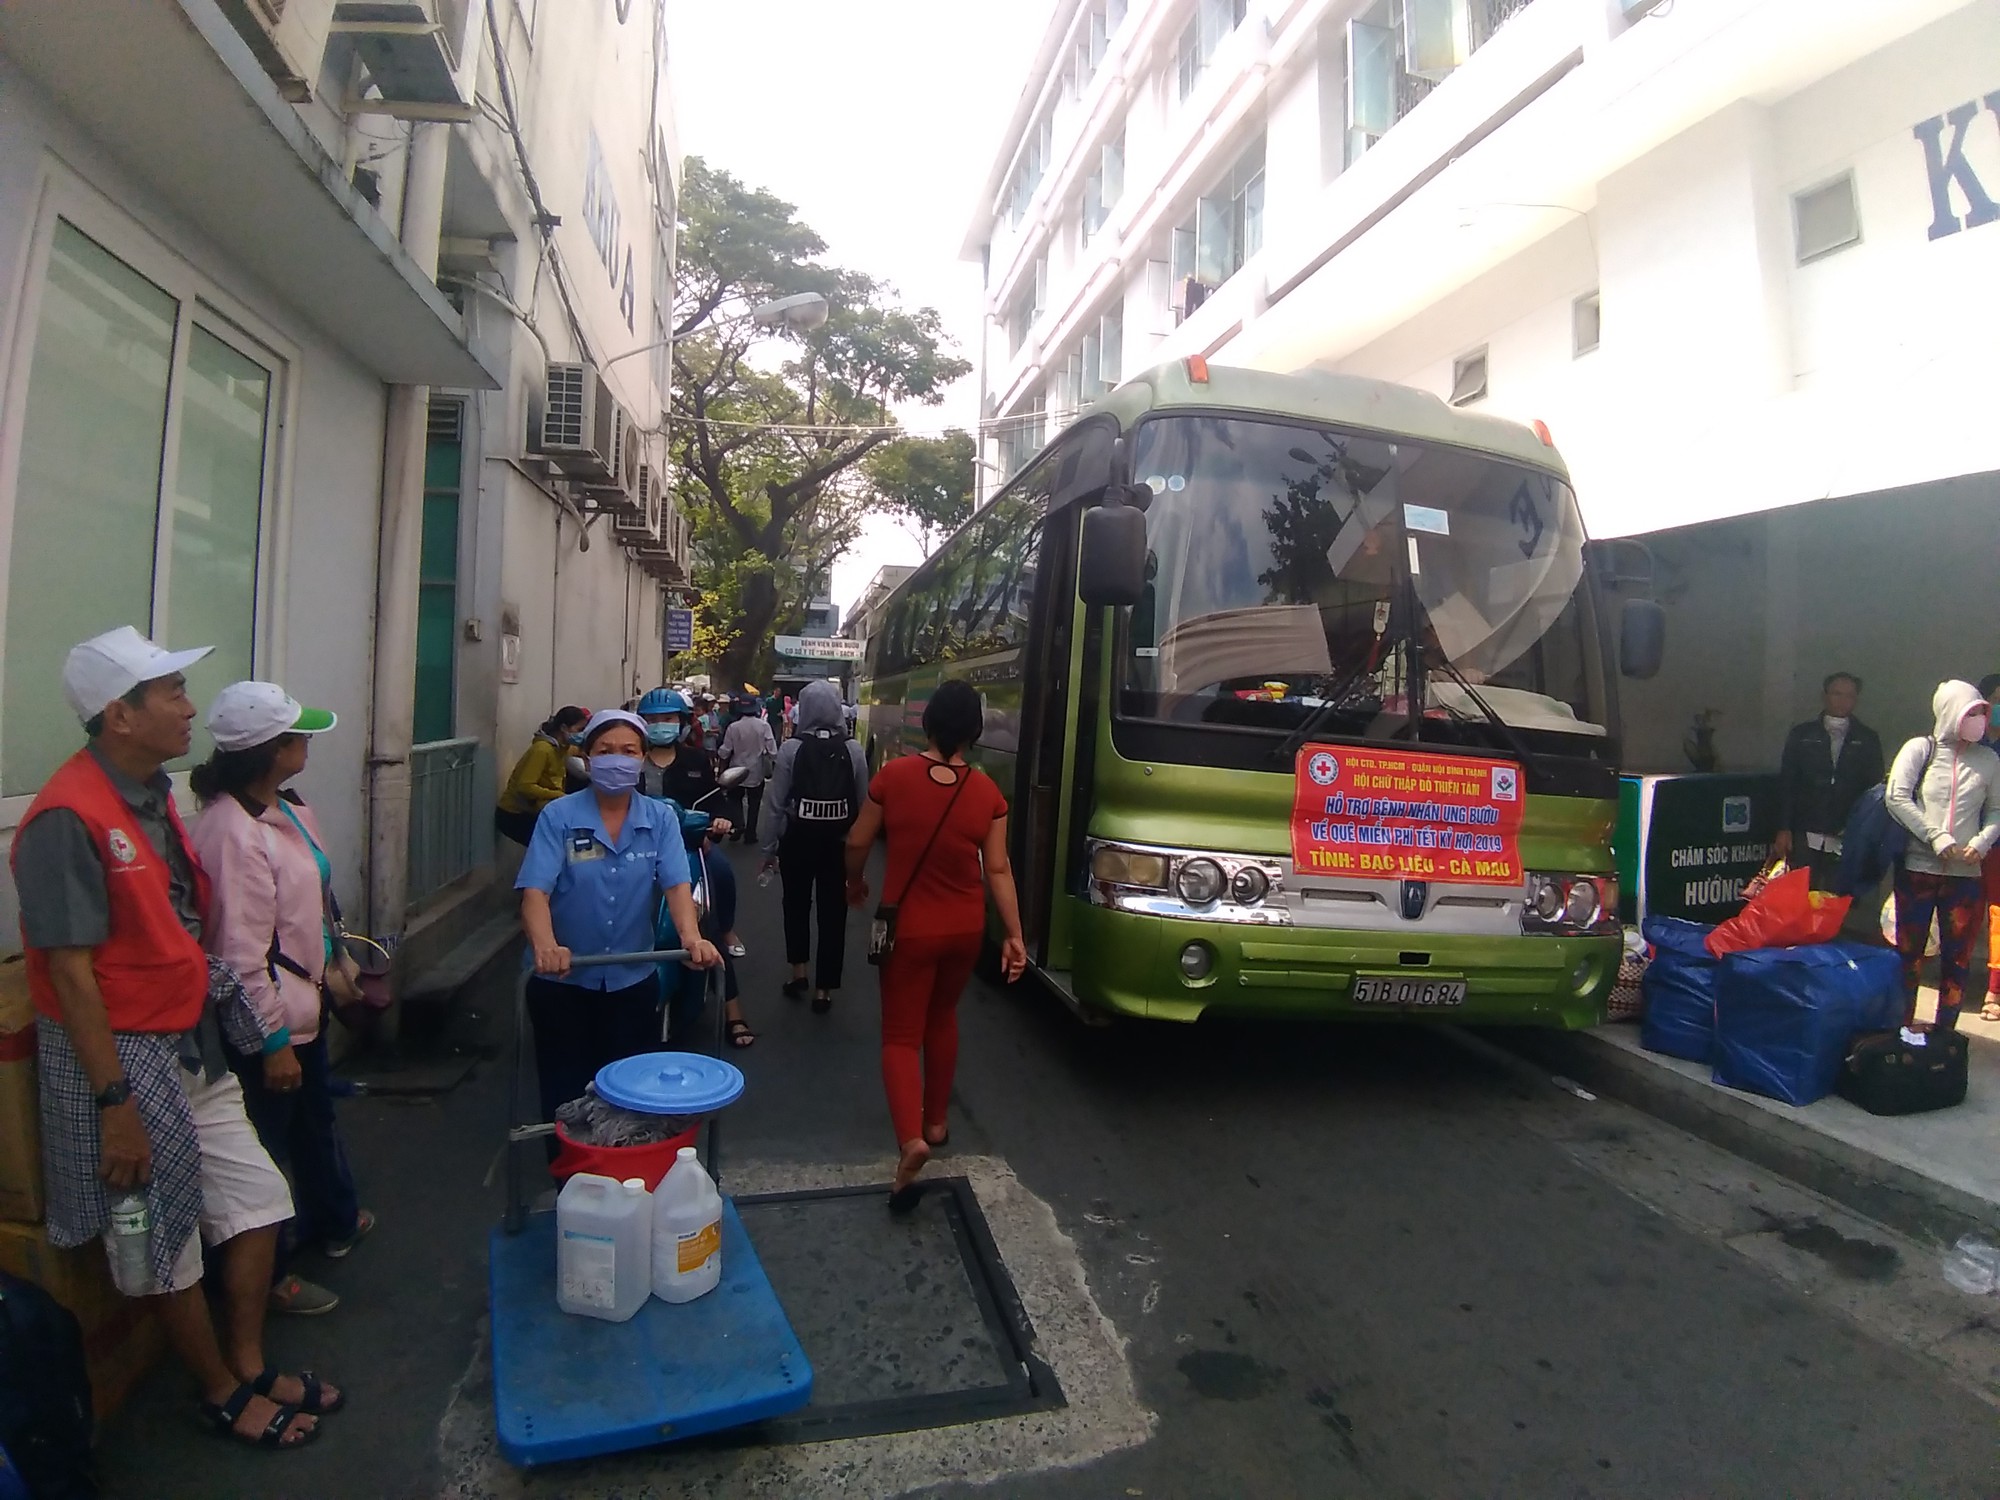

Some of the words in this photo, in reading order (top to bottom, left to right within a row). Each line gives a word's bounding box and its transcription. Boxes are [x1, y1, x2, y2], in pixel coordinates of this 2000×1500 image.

[1912, 89, 2000, 242] K
[1353, 772, 1370, 789] HỘI
[1372, 774, 1393, 789] CHỮ
[1394, 776, 1417, 793] THẬP
[802, 801, 847, 818] PUMA
[1326, 791, 1344, 814] HỖ
[1346, 797, 1372, 820] TRỢ
[1372, 797, 1406, 820] BỆNH
[1406, 800, 1441, 822] NHÂN
[1442, 804, 1467, 824] UNG
[1330, 822, 1357, 844] QUÊ
[1415, 825, 1437, 848] TẾT
[1474, 834, 1503, 852] 2019
[1309, 846, 1355, 868] TỈNH:
[1360, 854, 1395, 874] BẠC
[1398, 854, 1434, 874] LIÊU
[1449, 858, 1472, 875] CÀ
[1476, 860, 1511, 876] MAU
[1671, 846, 1704, 868] CHĂM
[1706, 842, 1728, 865] SÓC
[1731, 840, 1766, 863] KHÁCH
